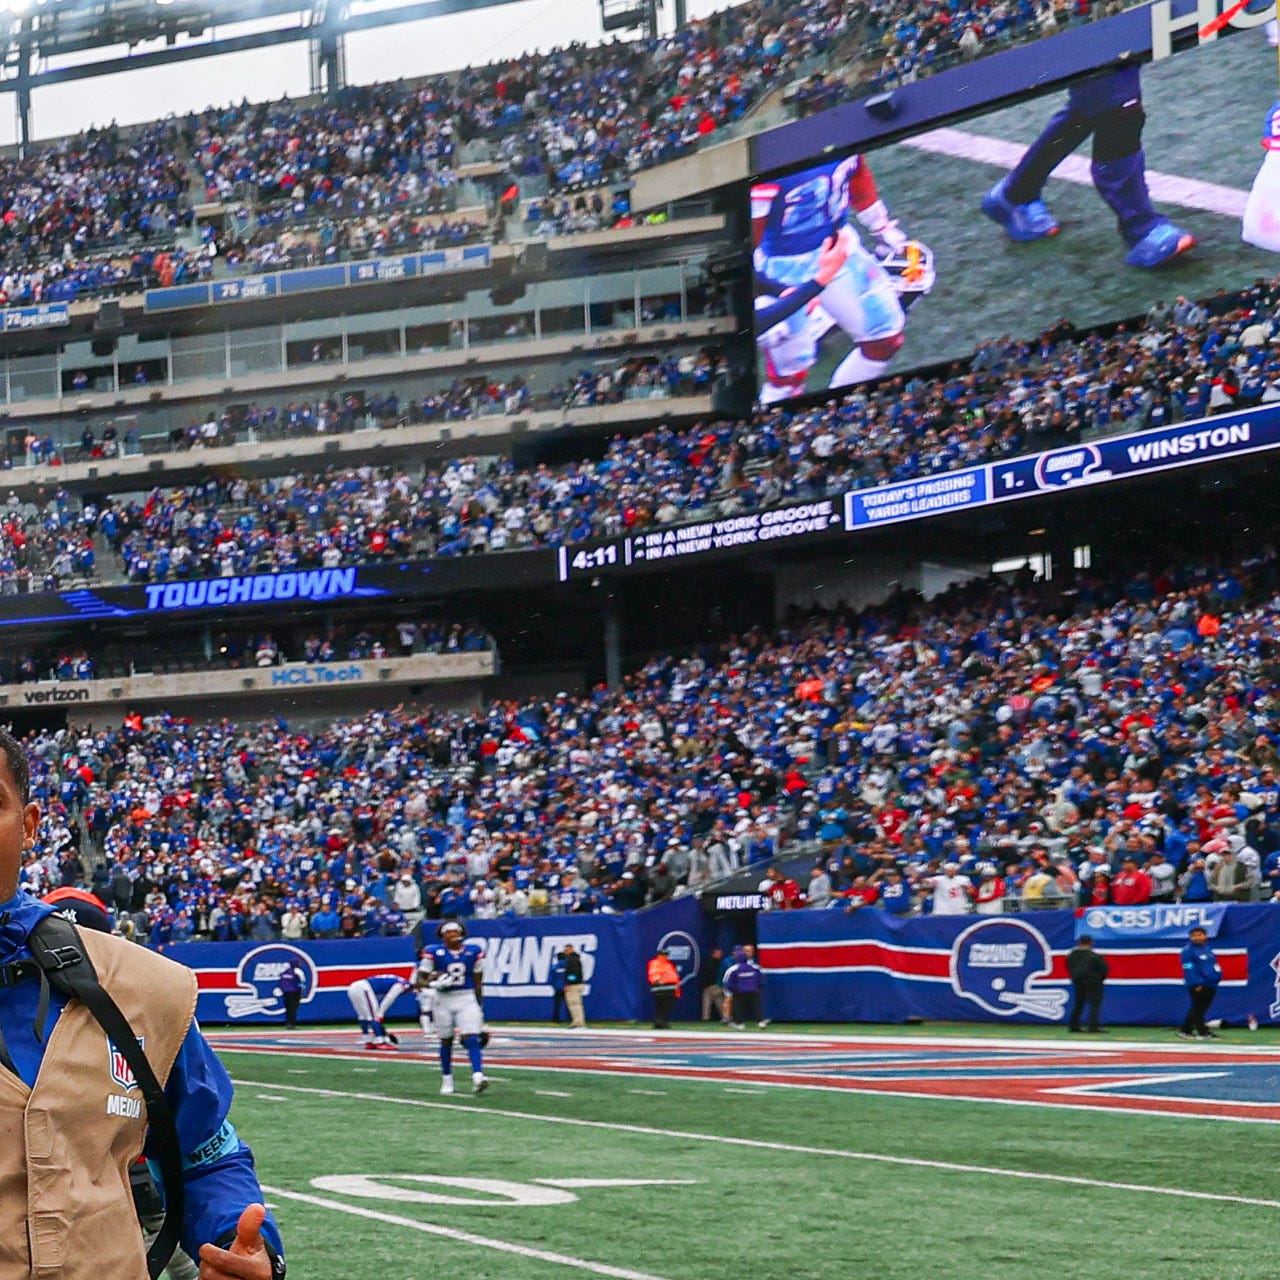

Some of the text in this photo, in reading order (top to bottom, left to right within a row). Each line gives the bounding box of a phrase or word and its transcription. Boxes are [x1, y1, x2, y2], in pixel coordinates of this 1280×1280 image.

[1128, 423, 1251, 464] WINSTON
[861, 475, 976, 507] TODAY'S PASSING
[865, 490, 971, 521] YARDS LEADERS
[646, 532, 663, 546] IN
[676, 523, 714, 541] NEW
[713, 515, 760, 534] YORK
[760, 500, 834, 525] GROOVE
[646, 547, 663, 560] IN
[676, 539, 714, 555] NEW
[712, 529, 758, 548] YORK
[758, 515, 830, 540] GROOVE
[571, 544, 617, 570] 4:11
[146, 567, 357, 610] TOUCHDOWN
[271, 664, 364, 687] HCLTech
[24, 686, 90, 704] verizon
[716, 895, 762, 910] METLIFE
[1104, 907, 1214, 929] CBS NFL
[968, 943, 1028, 967] GIANTS
[446, 962, 467, 986] 8
[106, 1094, 142, 1119] MEDIA
[190, 1135, 226, 1165] WEEK
